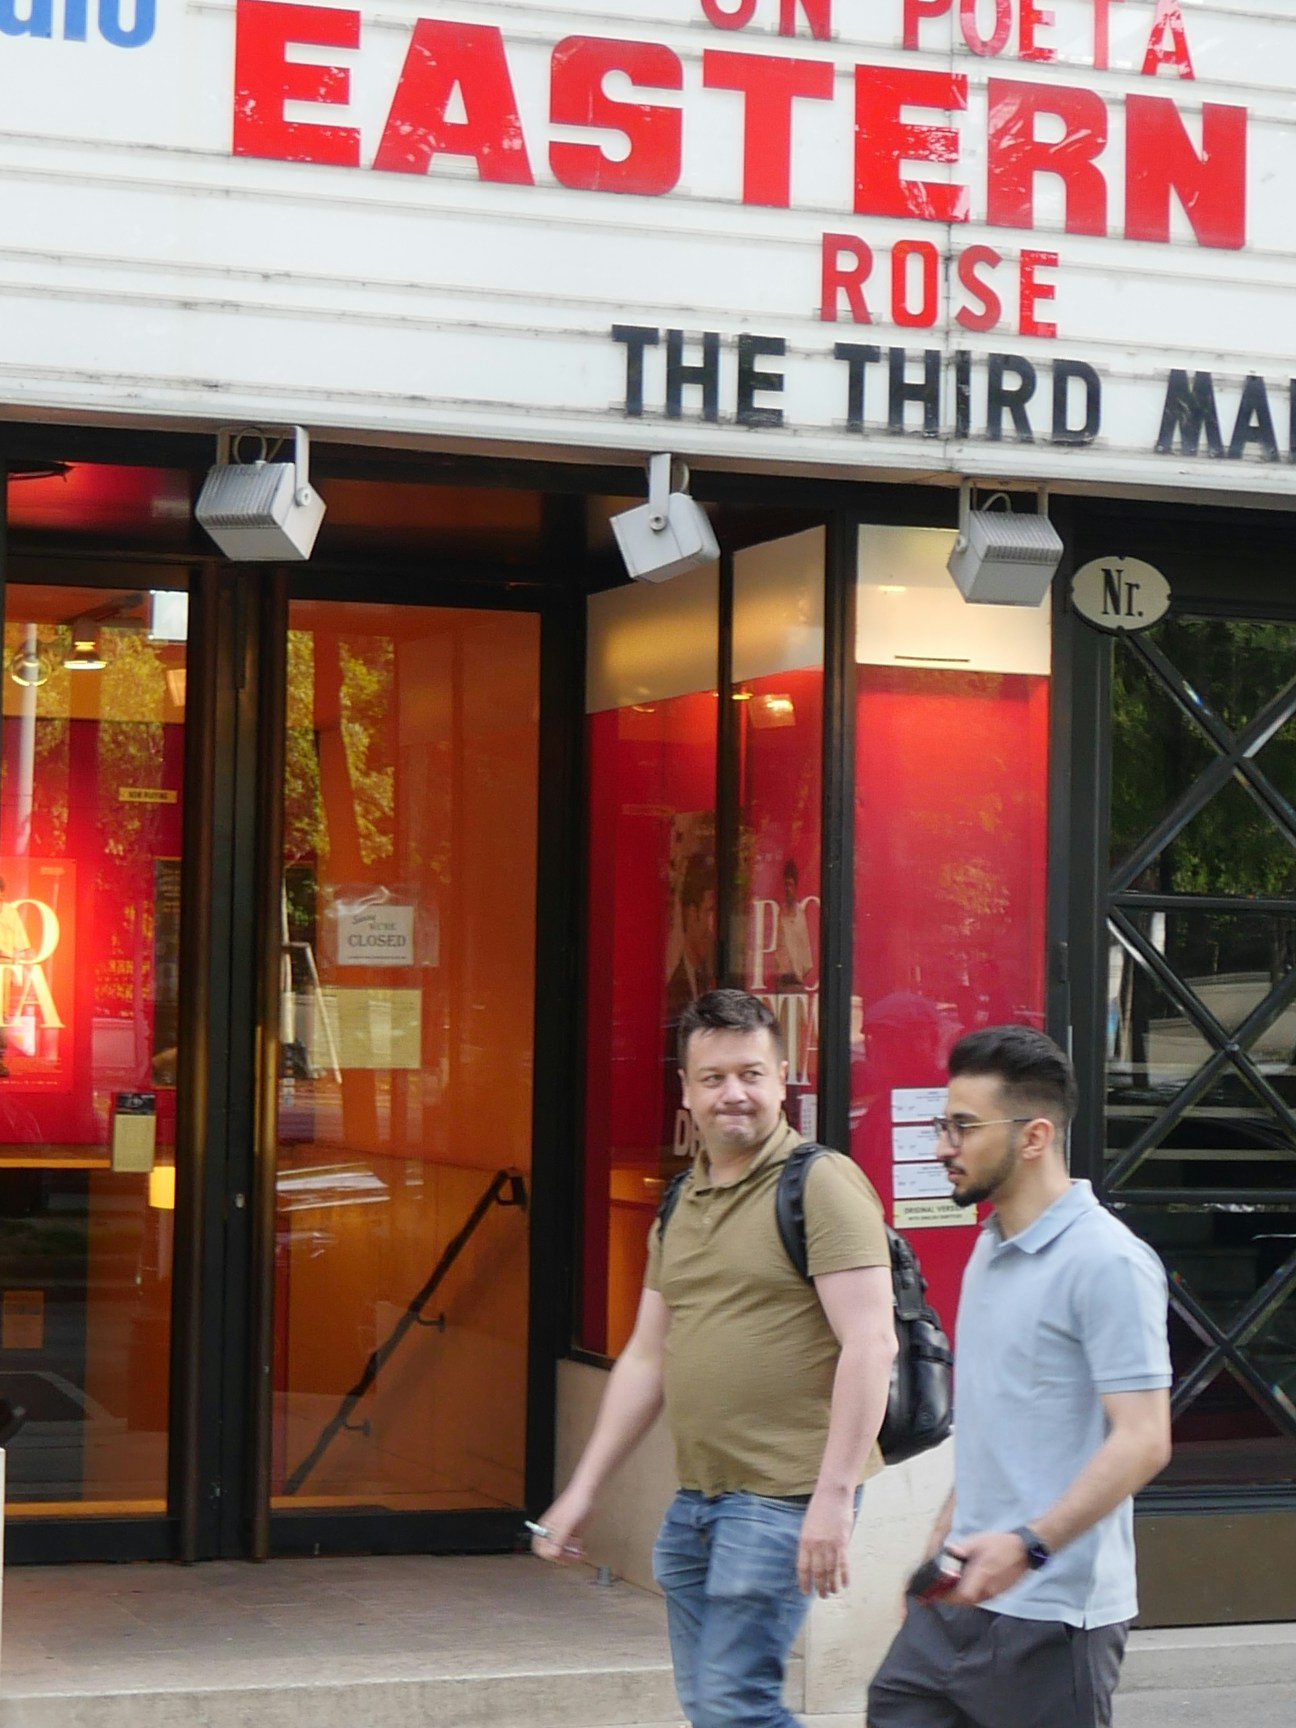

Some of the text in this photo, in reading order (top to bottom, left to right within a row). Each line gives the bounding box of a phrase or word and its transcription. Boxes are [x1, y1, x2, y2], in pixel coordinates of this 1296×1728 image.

[820, 233, 1059, 339] ROSE
[610, 324, 786, 429] THE
[834, 342, 1101, 447] THIRD
[1100, 567, 1144, 618] Nr.
[348, 934, 407, 948] CLOSED
